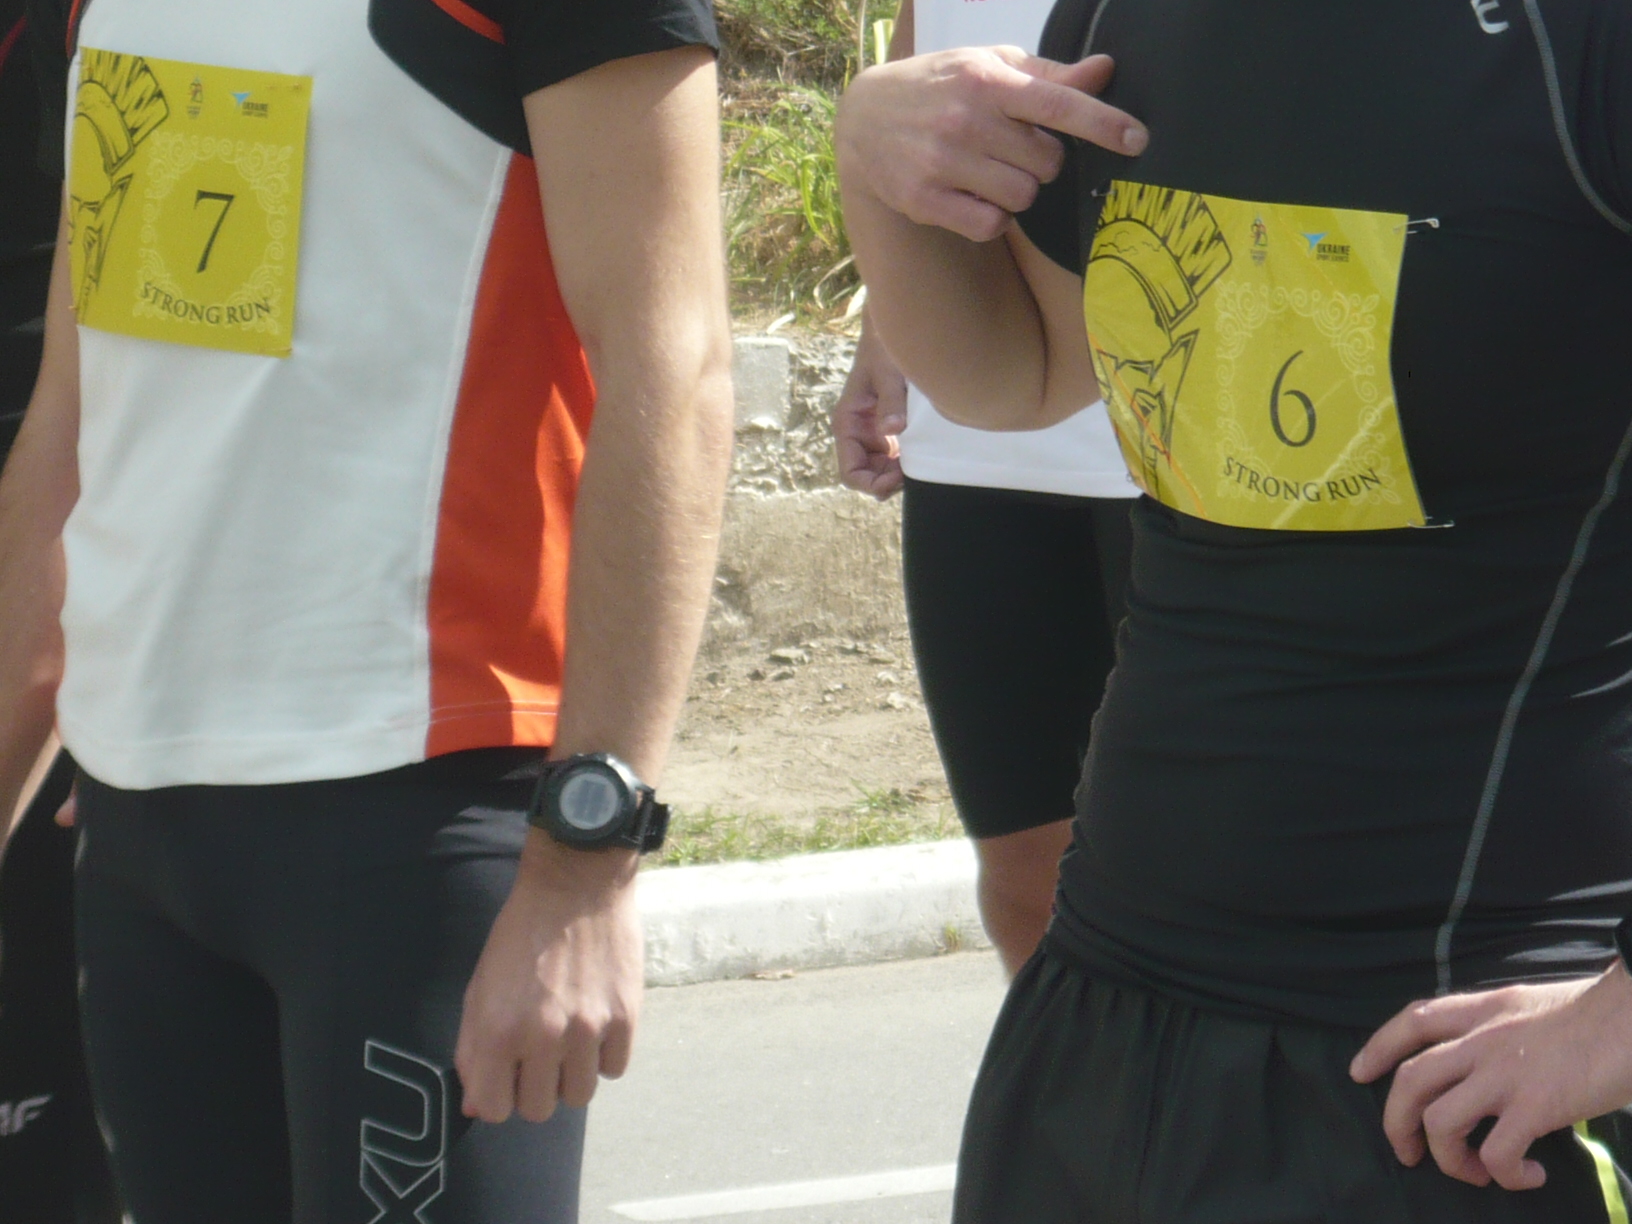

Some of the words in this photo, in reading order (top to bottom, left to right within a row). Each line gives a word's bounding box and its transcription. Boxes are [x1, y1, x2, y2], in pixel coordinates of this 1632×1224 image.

[194, 189, 235, 274] 7
[141, 281, 221, 325] STRONG
[226, 296, 271, 325] RUN
[1269, 349, 1318, 449] 6
[1223, 456, 1321, 502] STRONG
[1325, 467, 1382, 501] RUN
